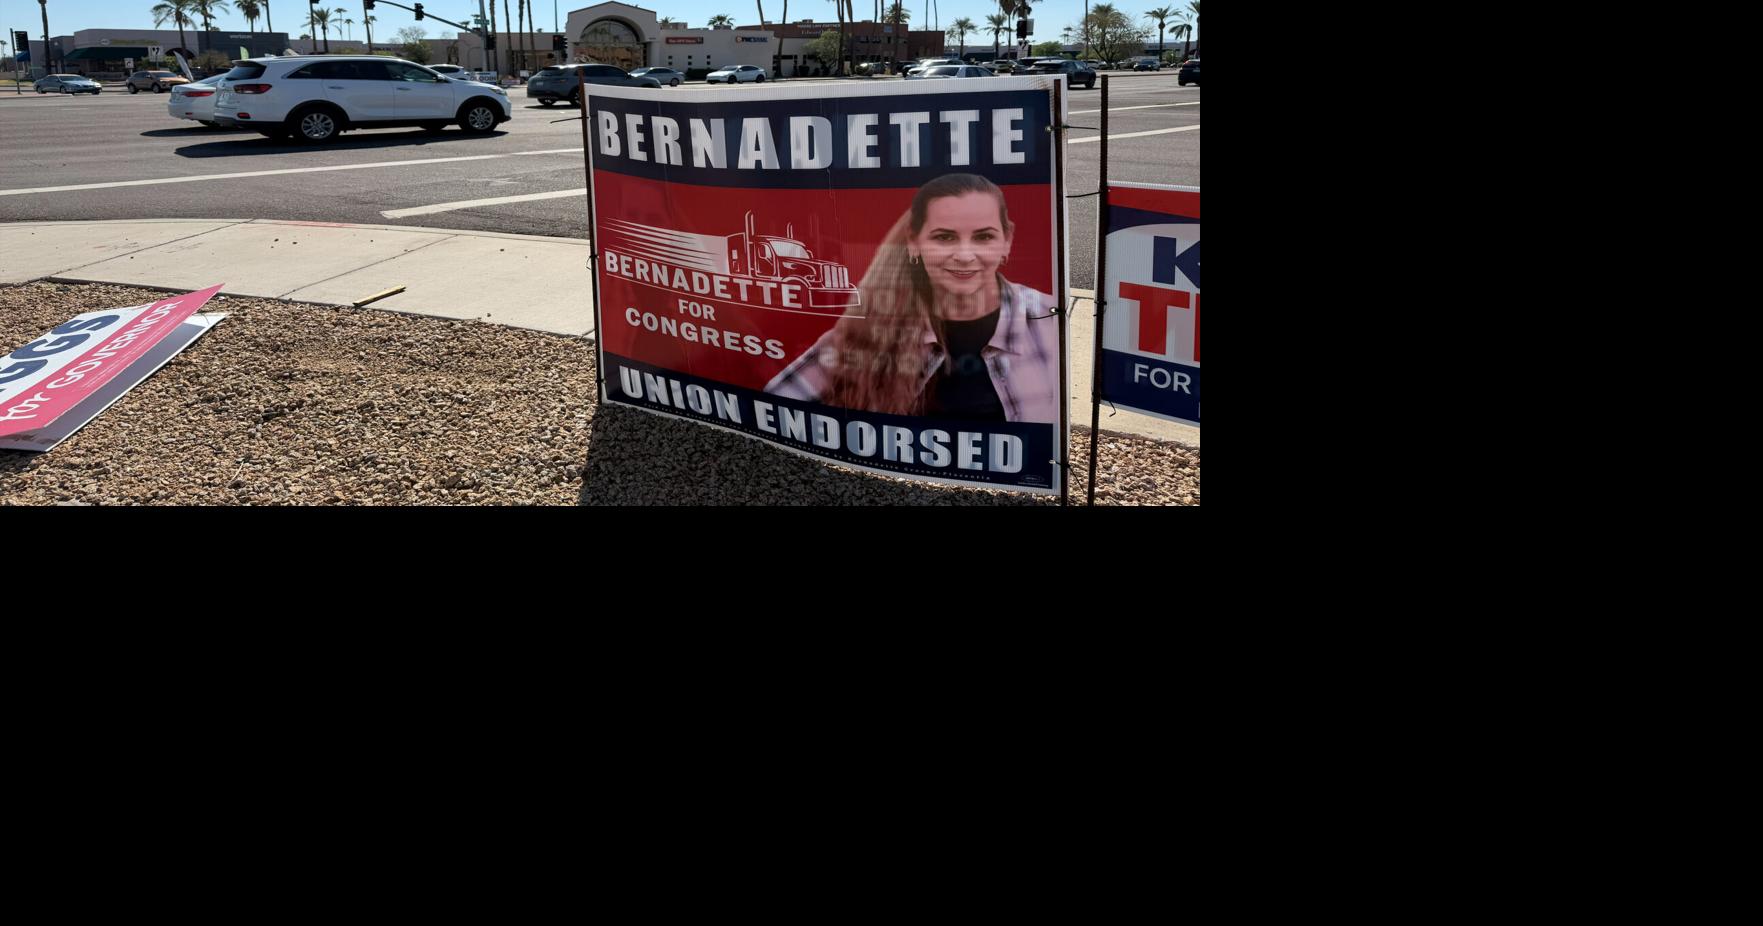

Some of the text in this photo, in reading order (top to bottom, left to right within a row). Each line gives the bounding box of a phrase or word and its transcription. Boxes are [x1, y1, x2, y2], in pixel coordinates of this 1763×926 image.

[597, 107, 1026, 170] BERNADETTE
[604, 251, 803, 308] BERNADETTE
[678, 298, 716, 321] FOR
[46, 300, 185, 389] GOVERNOR
[625, 307, 785, 360] CONGRESS
[1119, 281, 1200, 362] T
[0, 314, 120, 393] GGS
[1134, 362, 1191, 395] FOR
[619, 365, 742, 425] UNION
[753, 399, 1023, 474] ENDORSED
